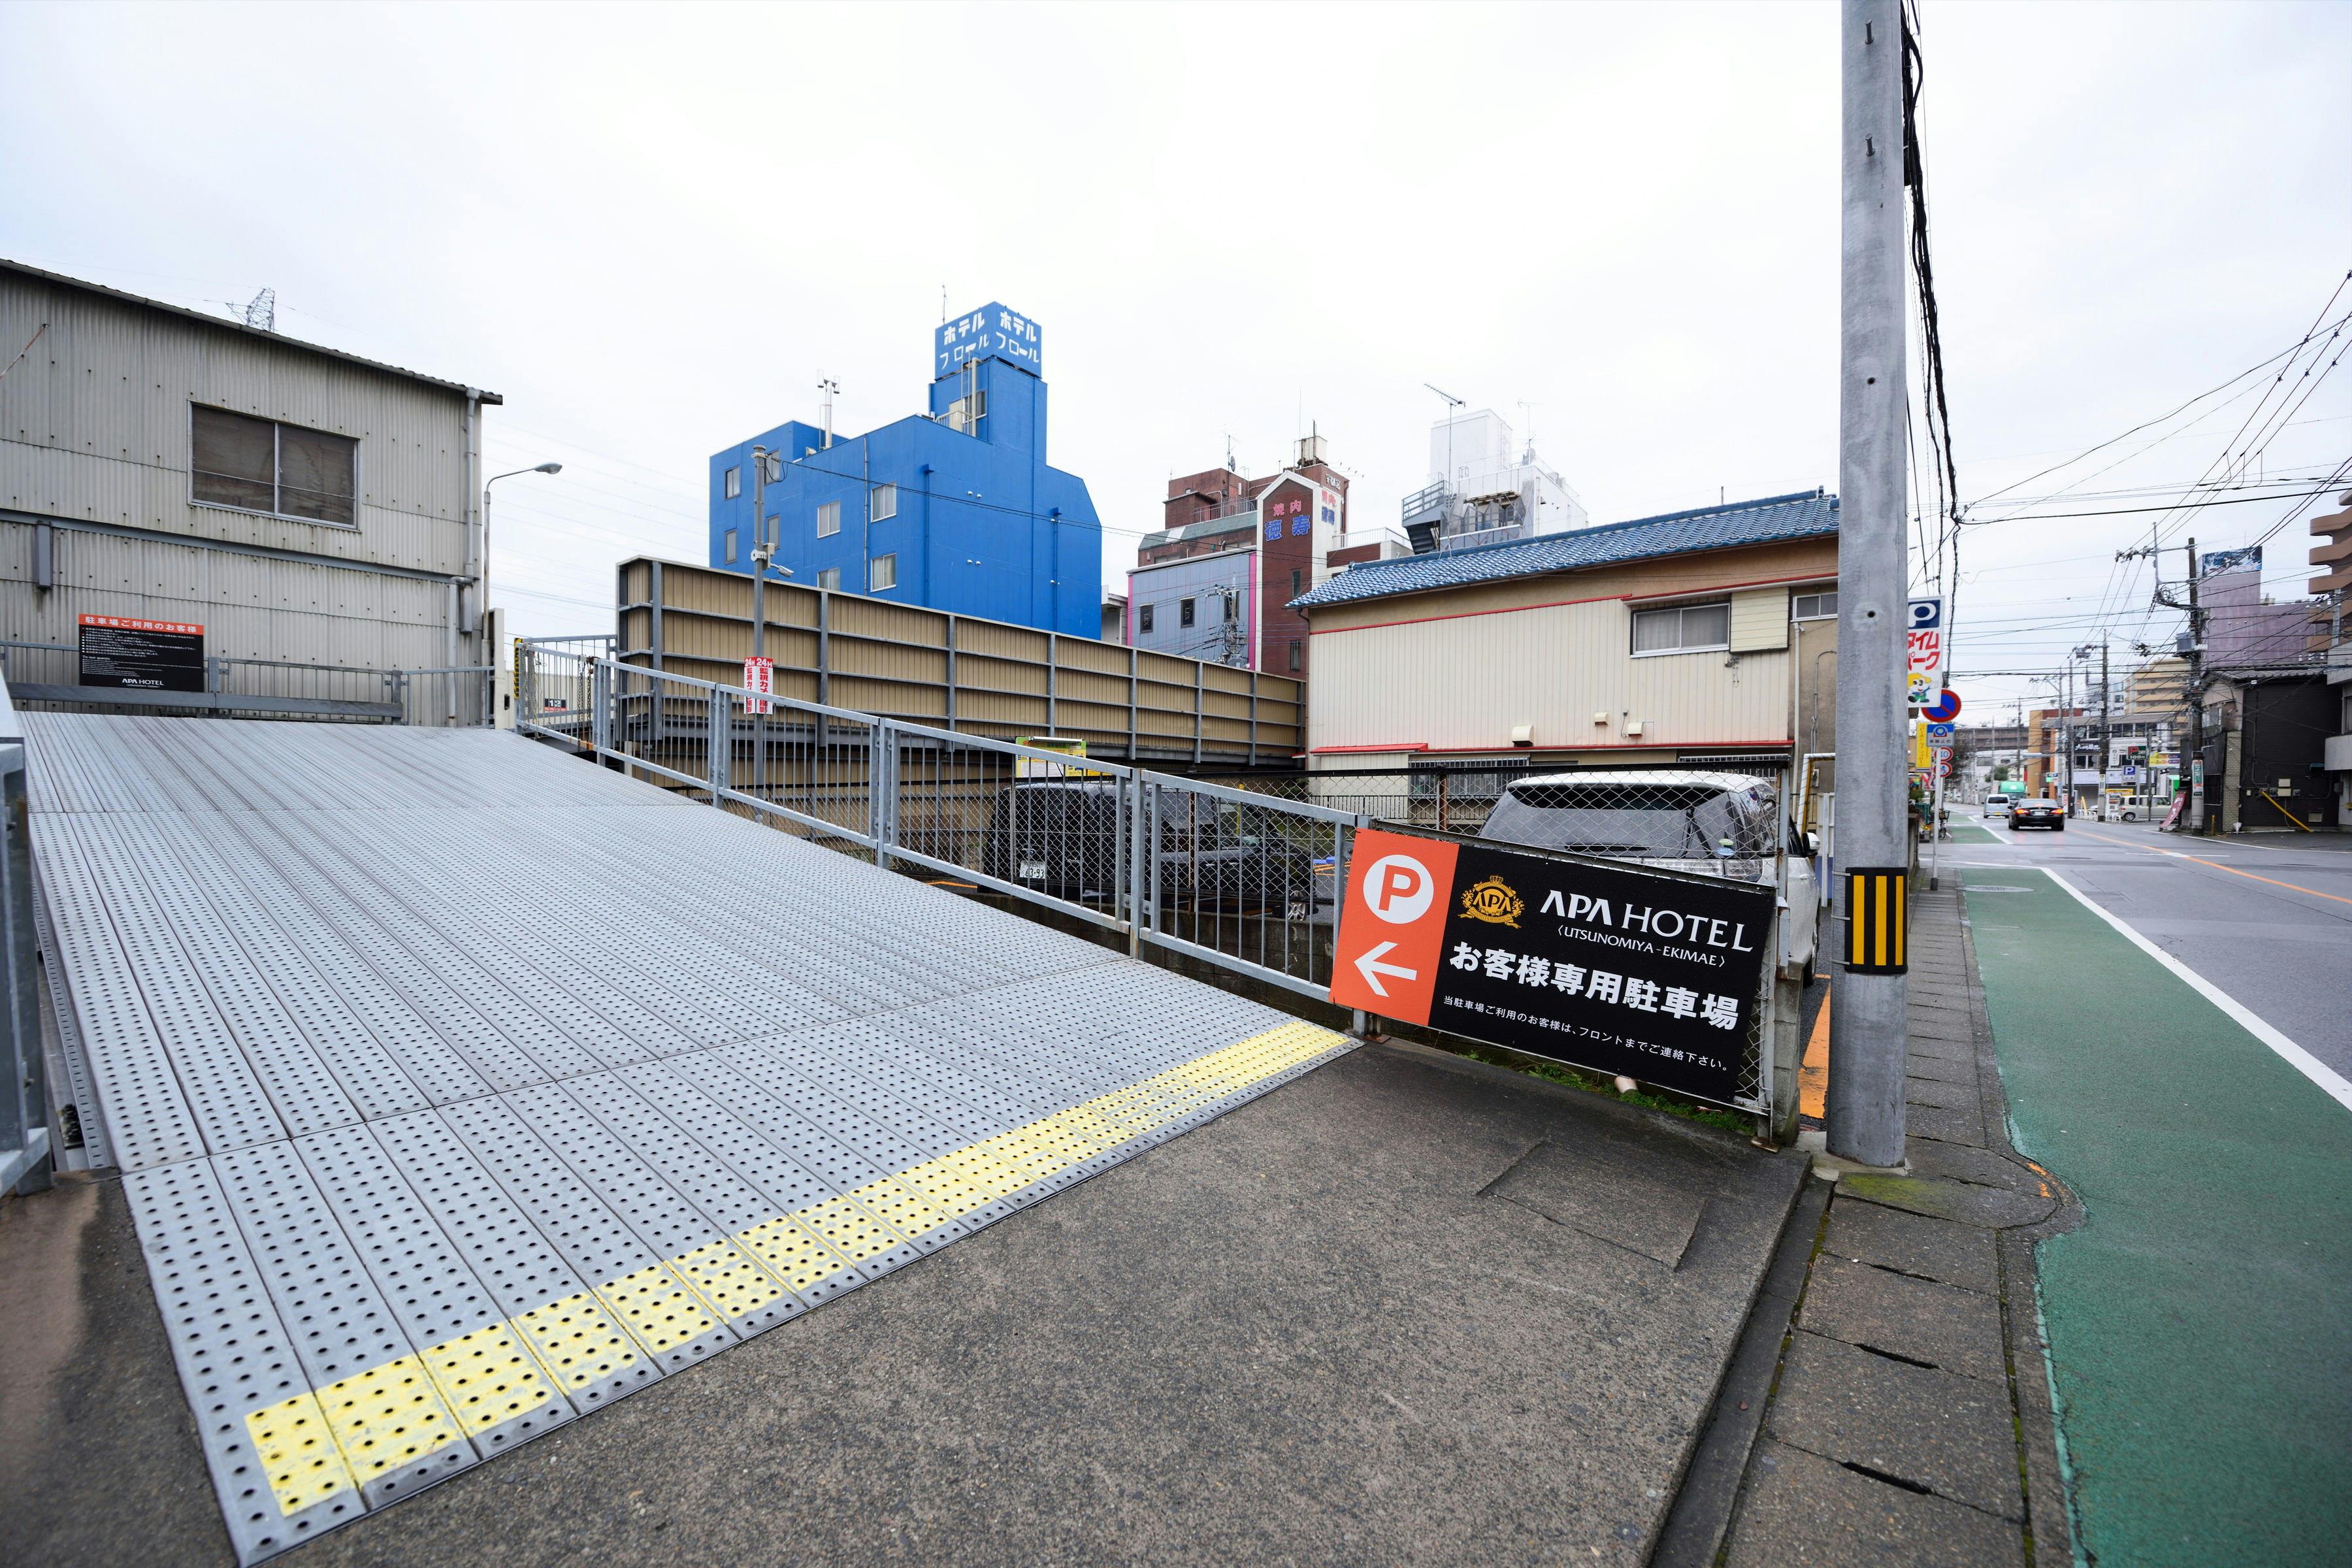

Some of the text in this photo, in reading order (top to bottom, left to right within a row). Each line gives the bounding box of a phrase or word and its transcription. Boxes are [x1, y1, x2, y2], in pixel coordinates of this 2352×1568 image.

[944, 312, 985, 346] ホテル
[1000, 311, 1037, 342] ホテル
[939, 334, 989, 370] フロール
[996, 331, 1039, 363] フロール
[1273, 499, 1301, 517] 焼肉
[1265, 515, 1311, 542] 徳寿
[85, 616, 197, 633] 駐車場ご利用のお客様
[1908, 603, 1936, 628] P
[745, 658, 755, 666] 24H
[757, 657, 772, 668] 24H
[759, 668, 768, 713] 監視カメ撮影
[1379, 864, 1421, 911] P
[1473, 892, 1512, 912] APA
[1540, 890, 1753, 953] APA HOTEL
[1449, 941, 1739, 1030] お客様専用駐車場
[1443, 995, 1727, 1071] 当駐車場ご利用のお客様は、フロントまでご連絡下さい。
